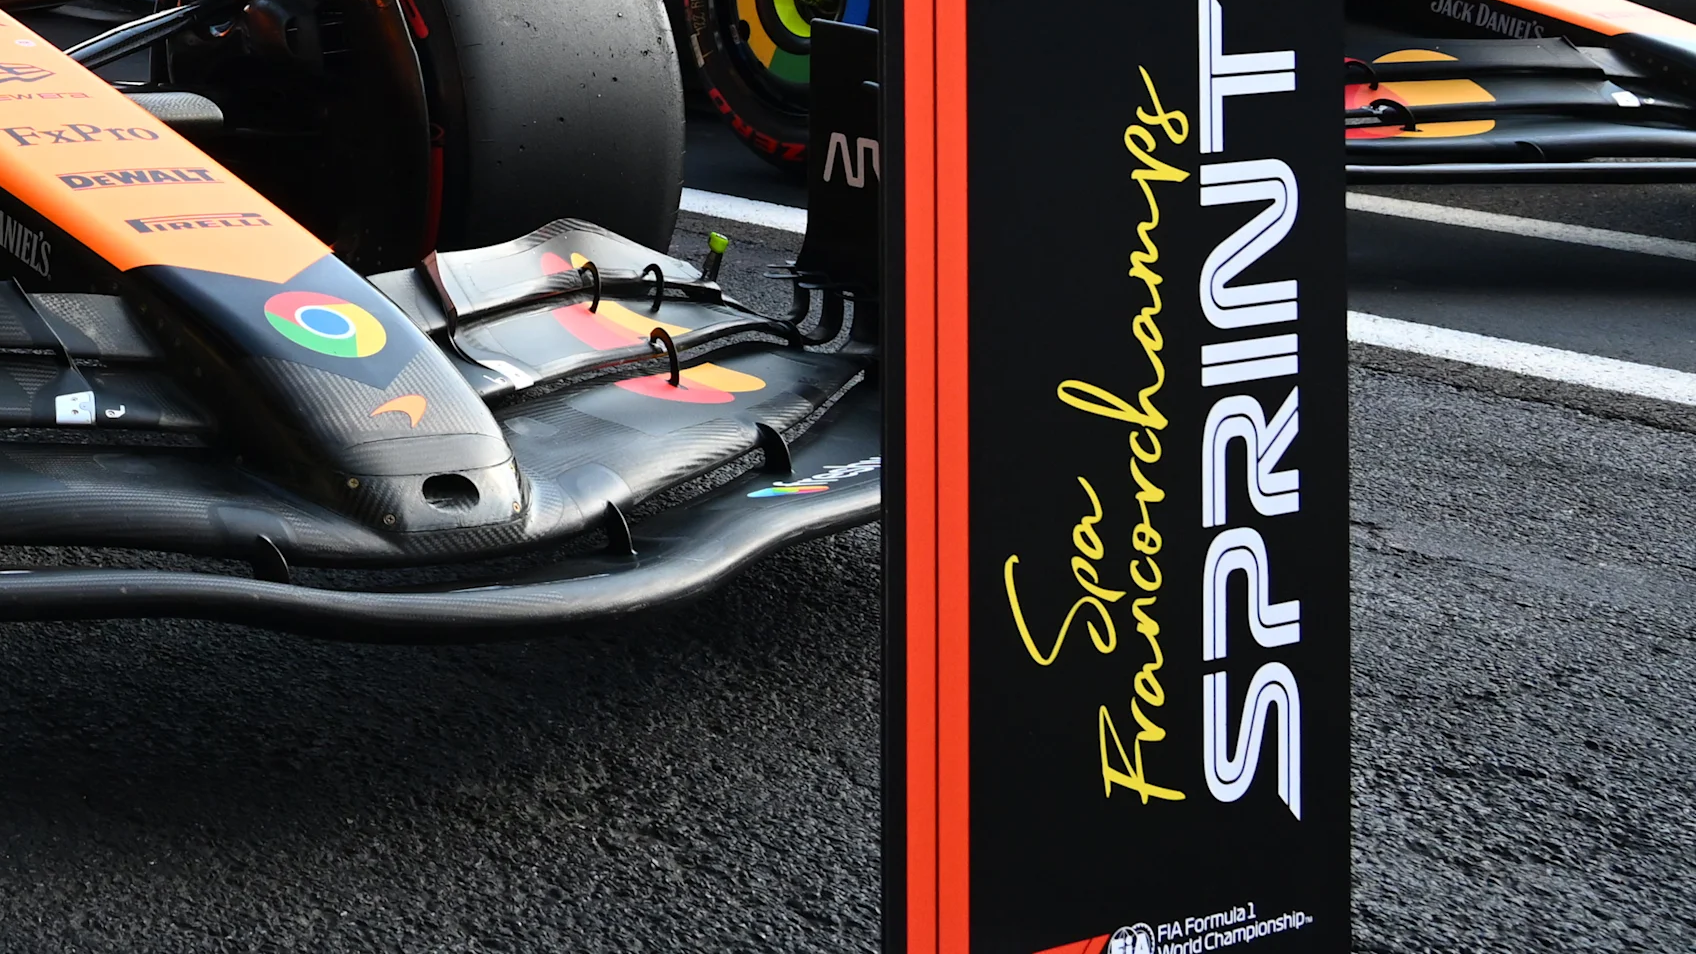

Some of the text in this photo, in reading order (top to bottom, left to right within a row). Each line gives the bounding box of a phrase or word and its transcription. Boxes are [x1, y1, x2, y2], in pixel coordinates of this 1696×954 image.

[124, 212, 274, 234] PIRELLI
[1003, 475, 1126, 666] Spa
[1157, 901, 1257, 943] FIA Formula 1
[1157, 935, 1203, 954] World
